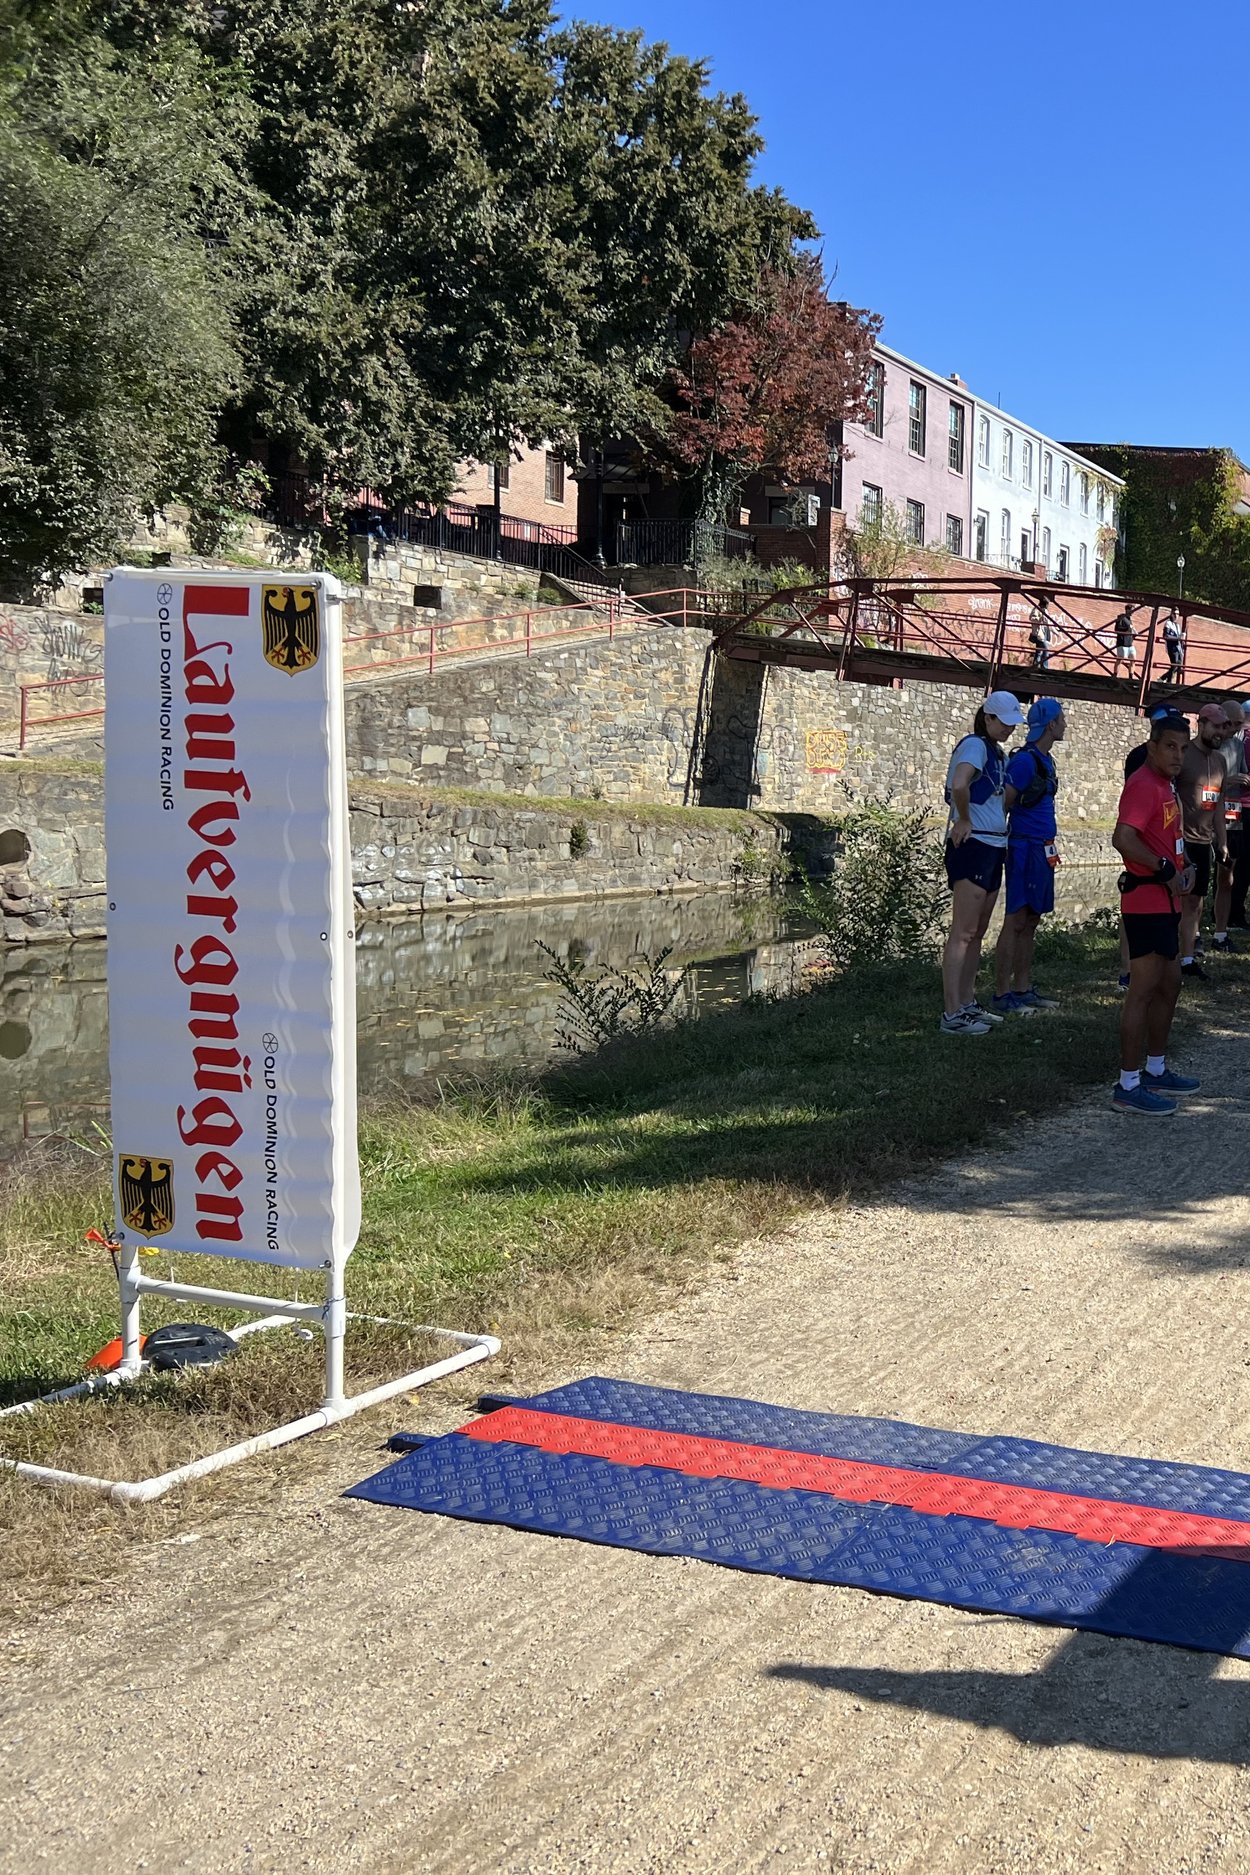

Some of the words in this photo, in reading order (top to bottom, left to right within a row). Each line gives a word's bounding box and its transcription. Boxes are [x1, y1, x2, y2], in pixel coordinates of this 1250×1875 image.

[158, 607, 171, 643] OLD
[160, 648, 172, 740] DOMINION
[161, 746, 174, 811] RACING
[174, 585, 252, 1241] Laufvergnügen
[264, 1056, 276, 1090] OLD
[265, 1095, 278, 1183] DOMINION
[265, 1189, 279, 1250] RACING
